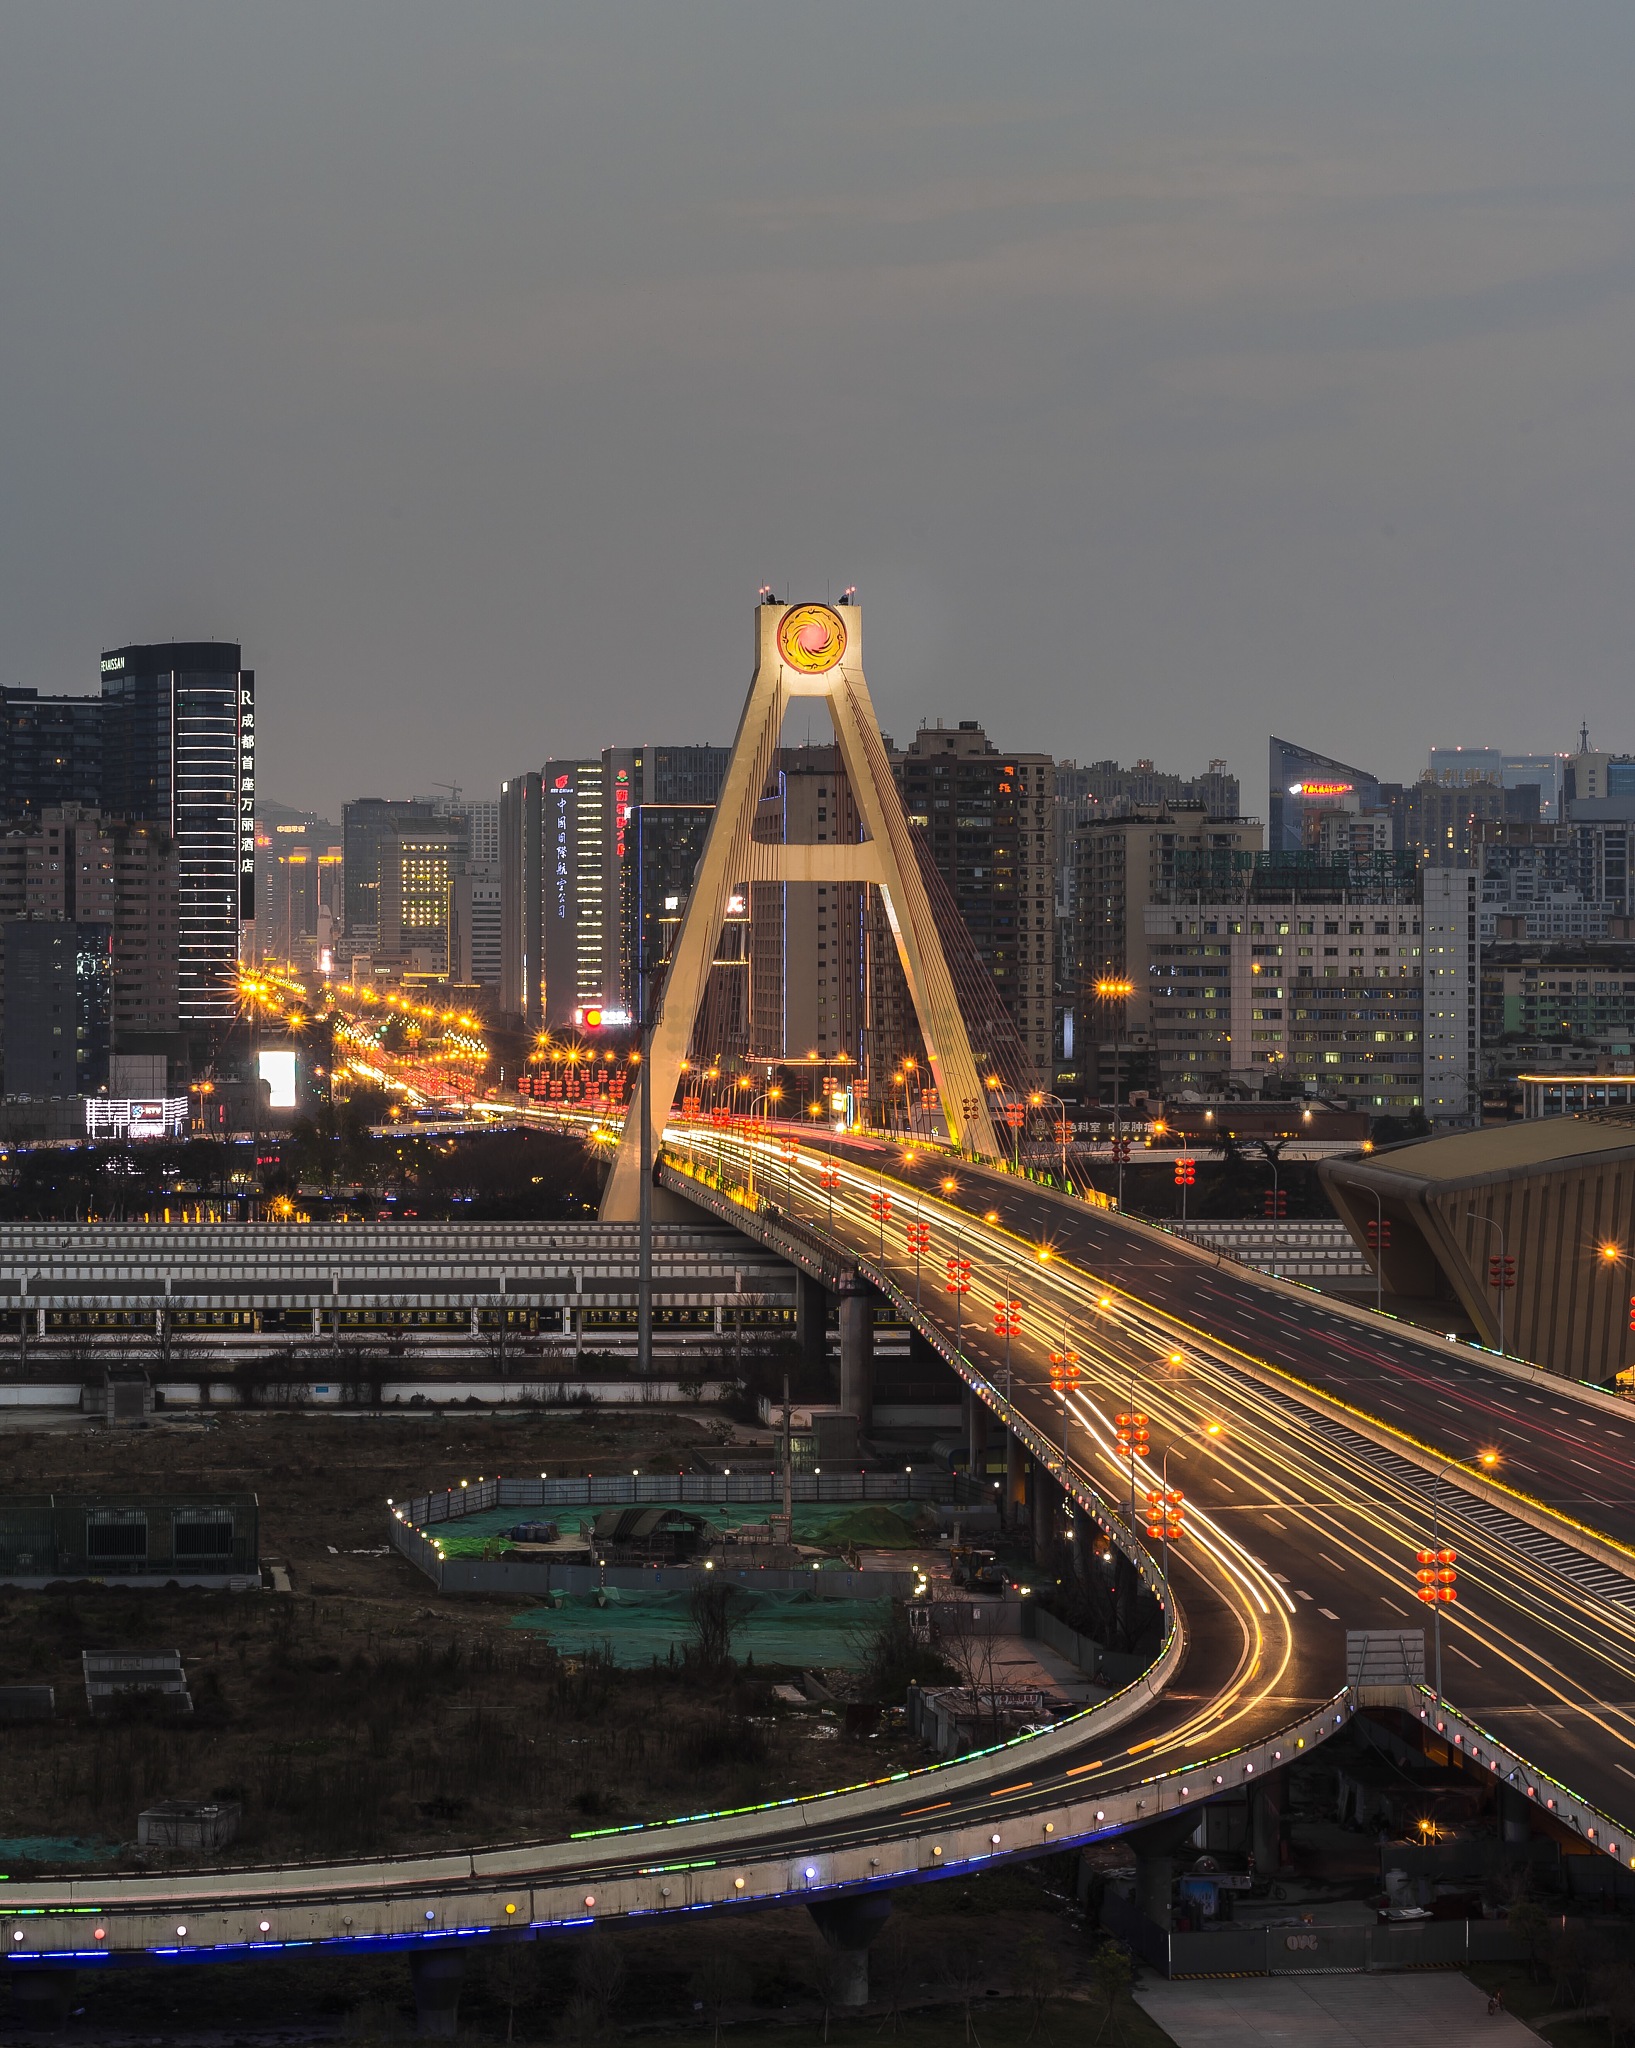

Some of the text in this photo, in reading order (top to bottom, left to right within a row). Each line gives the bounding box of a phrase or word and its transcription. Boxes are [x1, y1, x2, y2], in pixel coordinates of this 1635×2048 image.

[241, 690, 254, 705] R
[240, 713, 255, 873] 成都首座万丽酒店
